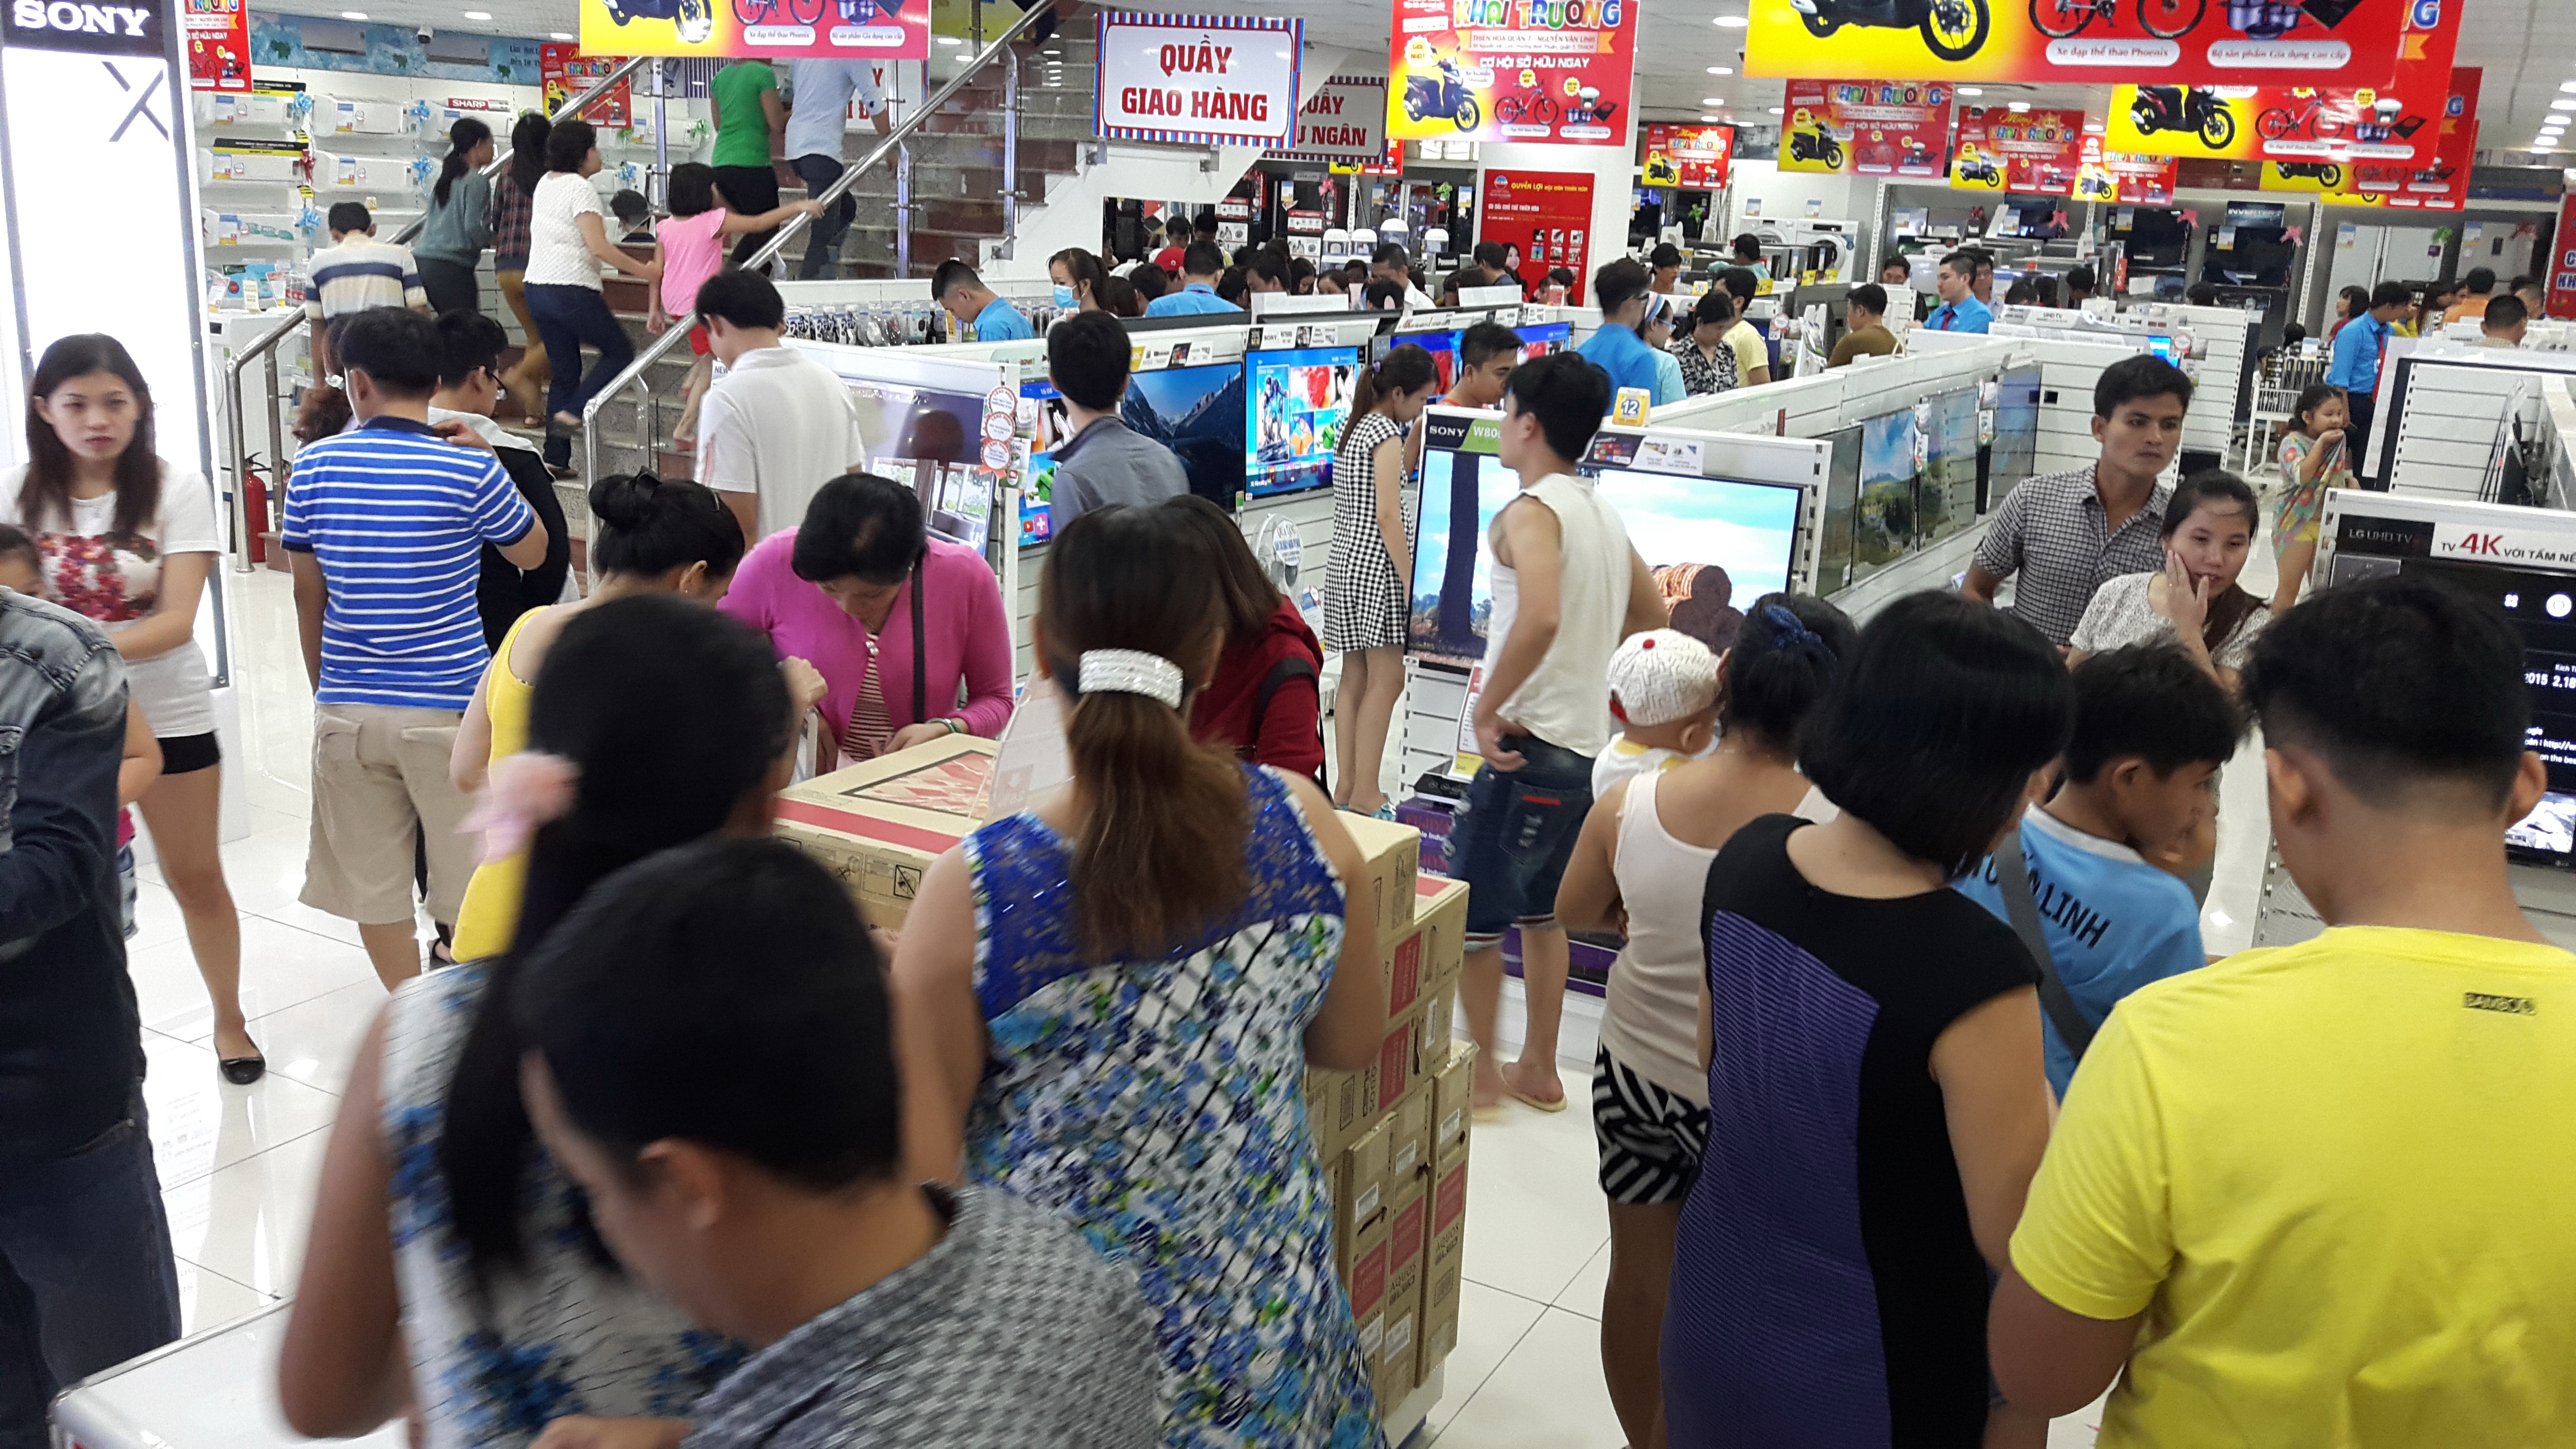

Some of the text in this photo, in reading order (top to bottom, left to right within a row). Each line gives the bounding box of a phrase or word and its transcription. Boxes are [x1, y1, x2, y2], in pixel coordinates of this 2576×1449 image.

[14, 1, 150, 36] SONY
[1160, 34, 1233, 77] QUẦY
[2108, 46, 2129, 55] thao
[2131, 47, 2168, 56] Phoenix
[1557, 56, 1590, 68] NGAY
[452, 99, 486, 110] SHARP
[1121, 86, 1268, 122] GIAO HÀNG
[1311, 122, 1367, 146] NGÂN
[1621, 399, 1640, 415] 12
[1429, 425, 1465, 437] SONY
[2348, 529, 2365, 539] LG
[2395, 532, 2413, 544] TV
[2441, 542, 2456, 552] TV
[2460, 533, 2504, 556] 4K
[2039, 882, 2112, 950] LINH
